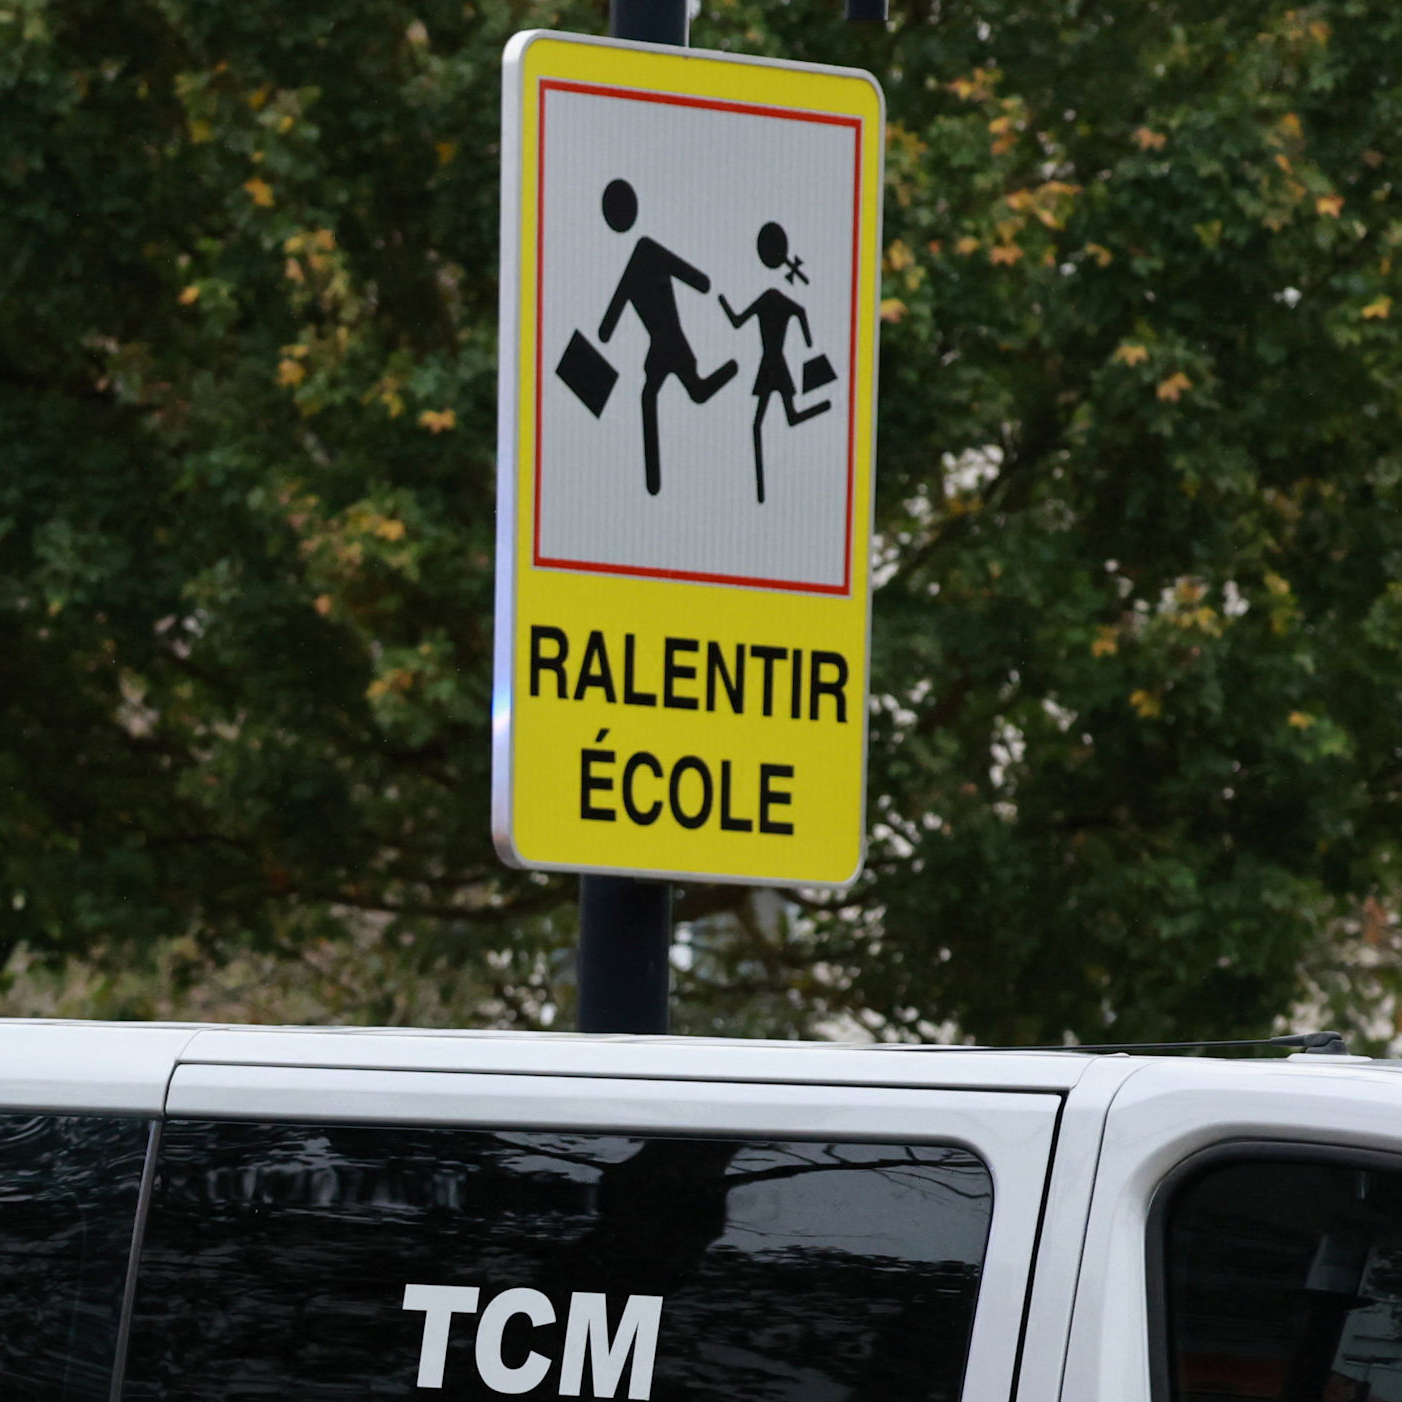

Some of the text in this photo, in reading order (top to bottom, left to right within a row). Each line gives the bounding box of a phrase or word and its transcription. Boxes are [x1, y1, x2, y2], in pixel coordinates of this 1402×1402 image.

[529, 624, 851, 723] RALENTIR
[579, 728, 796, 837] ÉCOLE
[401, 1283, 664, 1401] TCM
